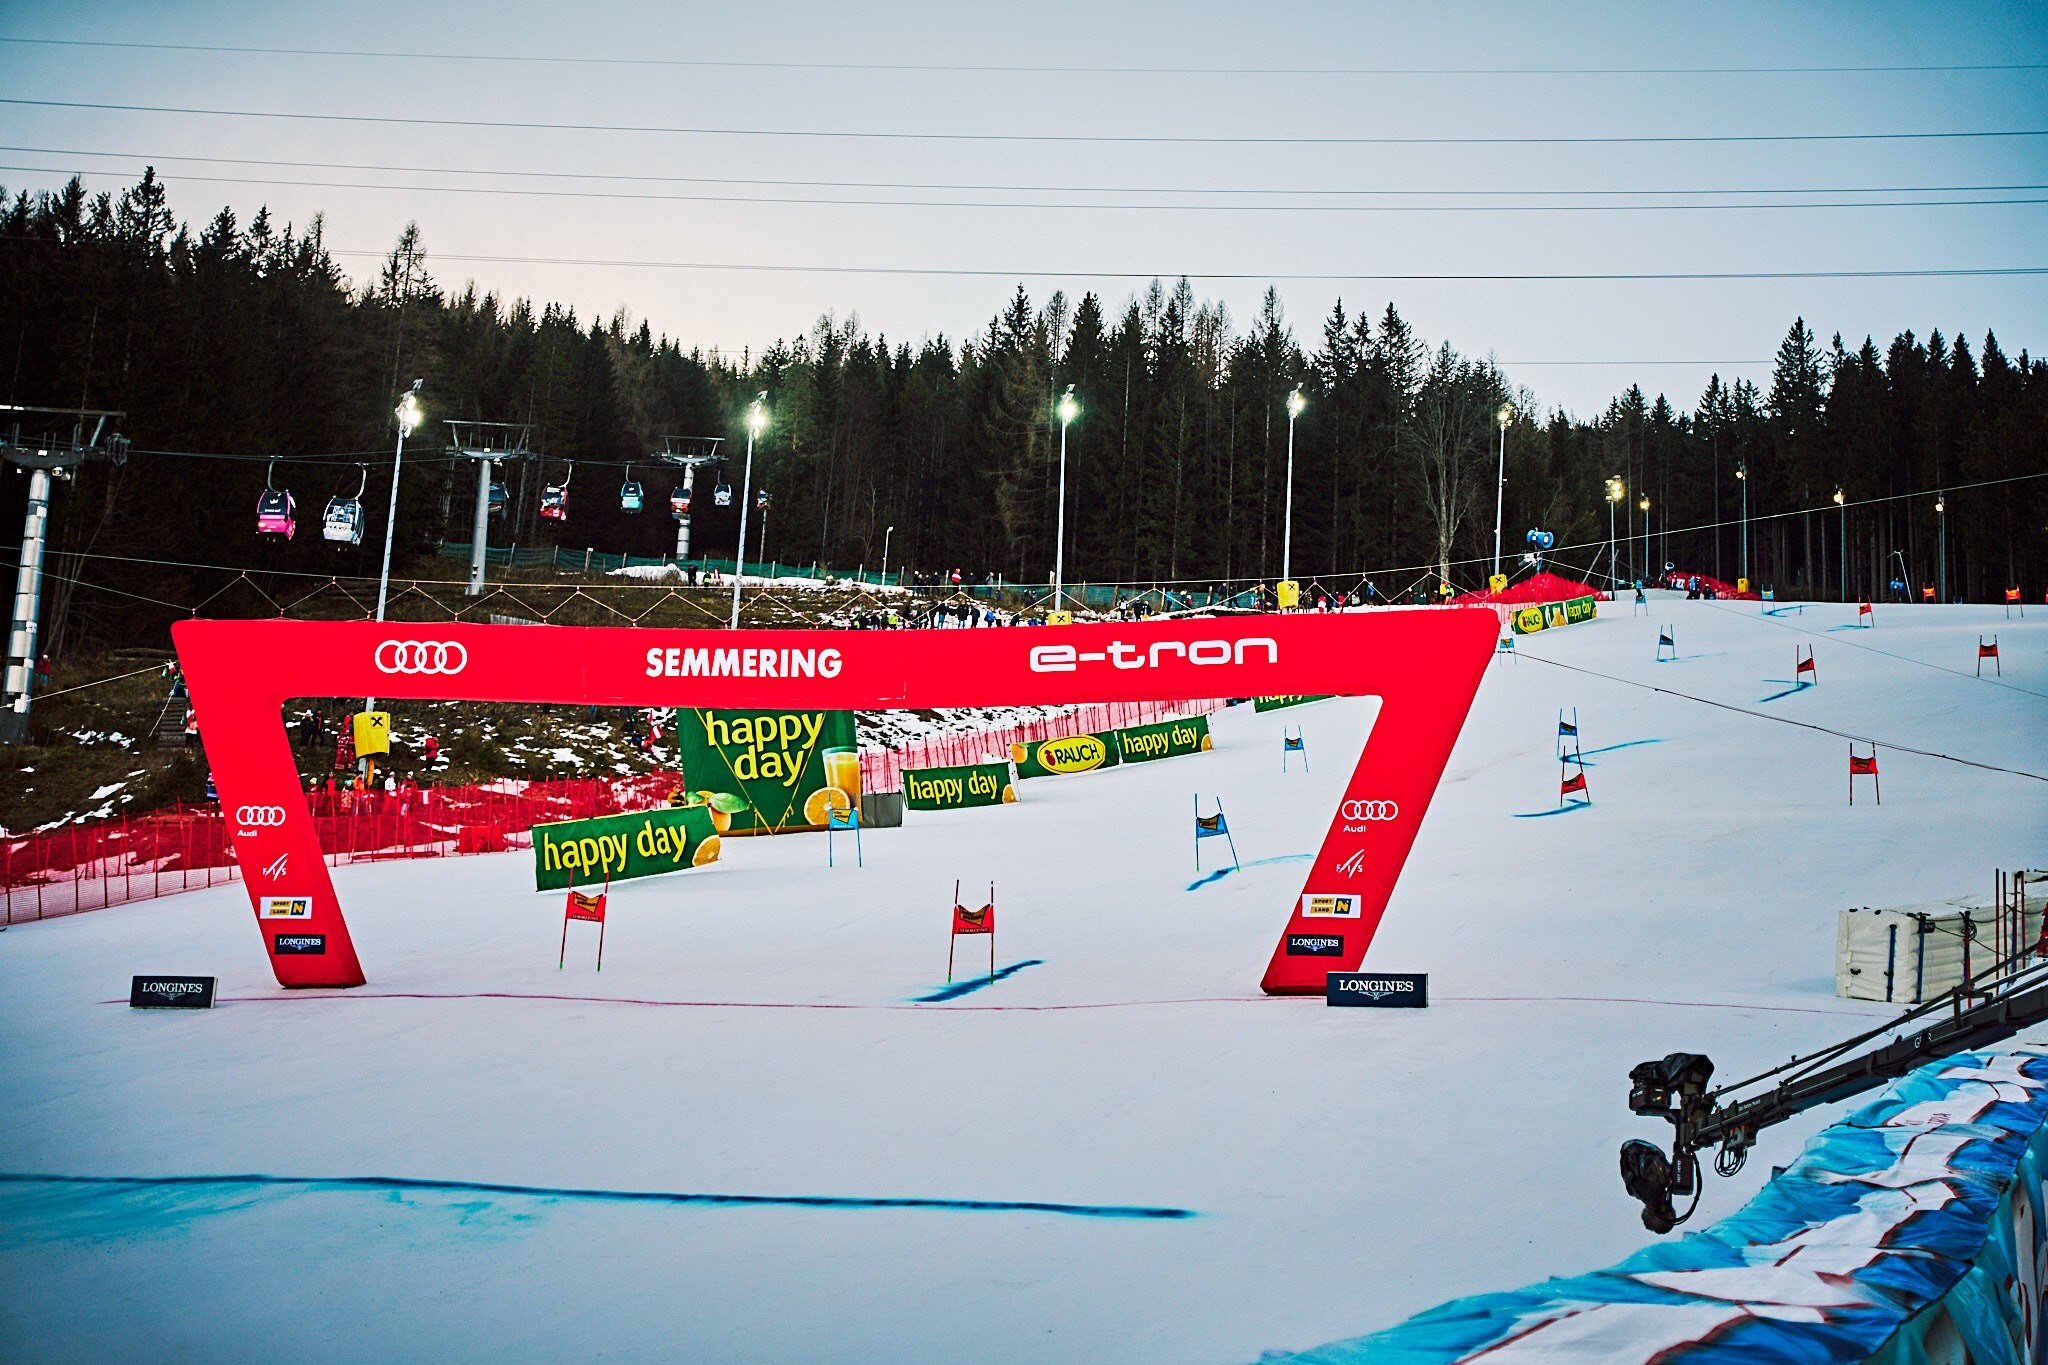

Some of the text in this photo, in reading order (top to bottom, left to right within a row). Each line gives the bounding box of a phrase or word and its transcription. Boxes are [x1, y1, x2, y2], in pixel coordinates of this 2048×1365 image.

[646, 647, 843, 678] SEMMERING
[1029, 637, 1278, 672] e-tron
[705, 711, 824, 752] happy
[1122, 725, 1197, 757] happy day
[734, 745, 805, 787] day
[1054, 744, 1101, 765] RAUCH
[908, 770, 998, 805] happy day
[237, 829, 258, 837] Audi
[1343, 824, 1366, 833] Audi
[544, 819, 687, 877] happy day
[279, 938, 322, 946] LONGINES
[1291, 938, 1339, 947] LONGINES
[142, 982, 203, 994] LONGINES
[1339, 979, 1414, 992] LONGINES
